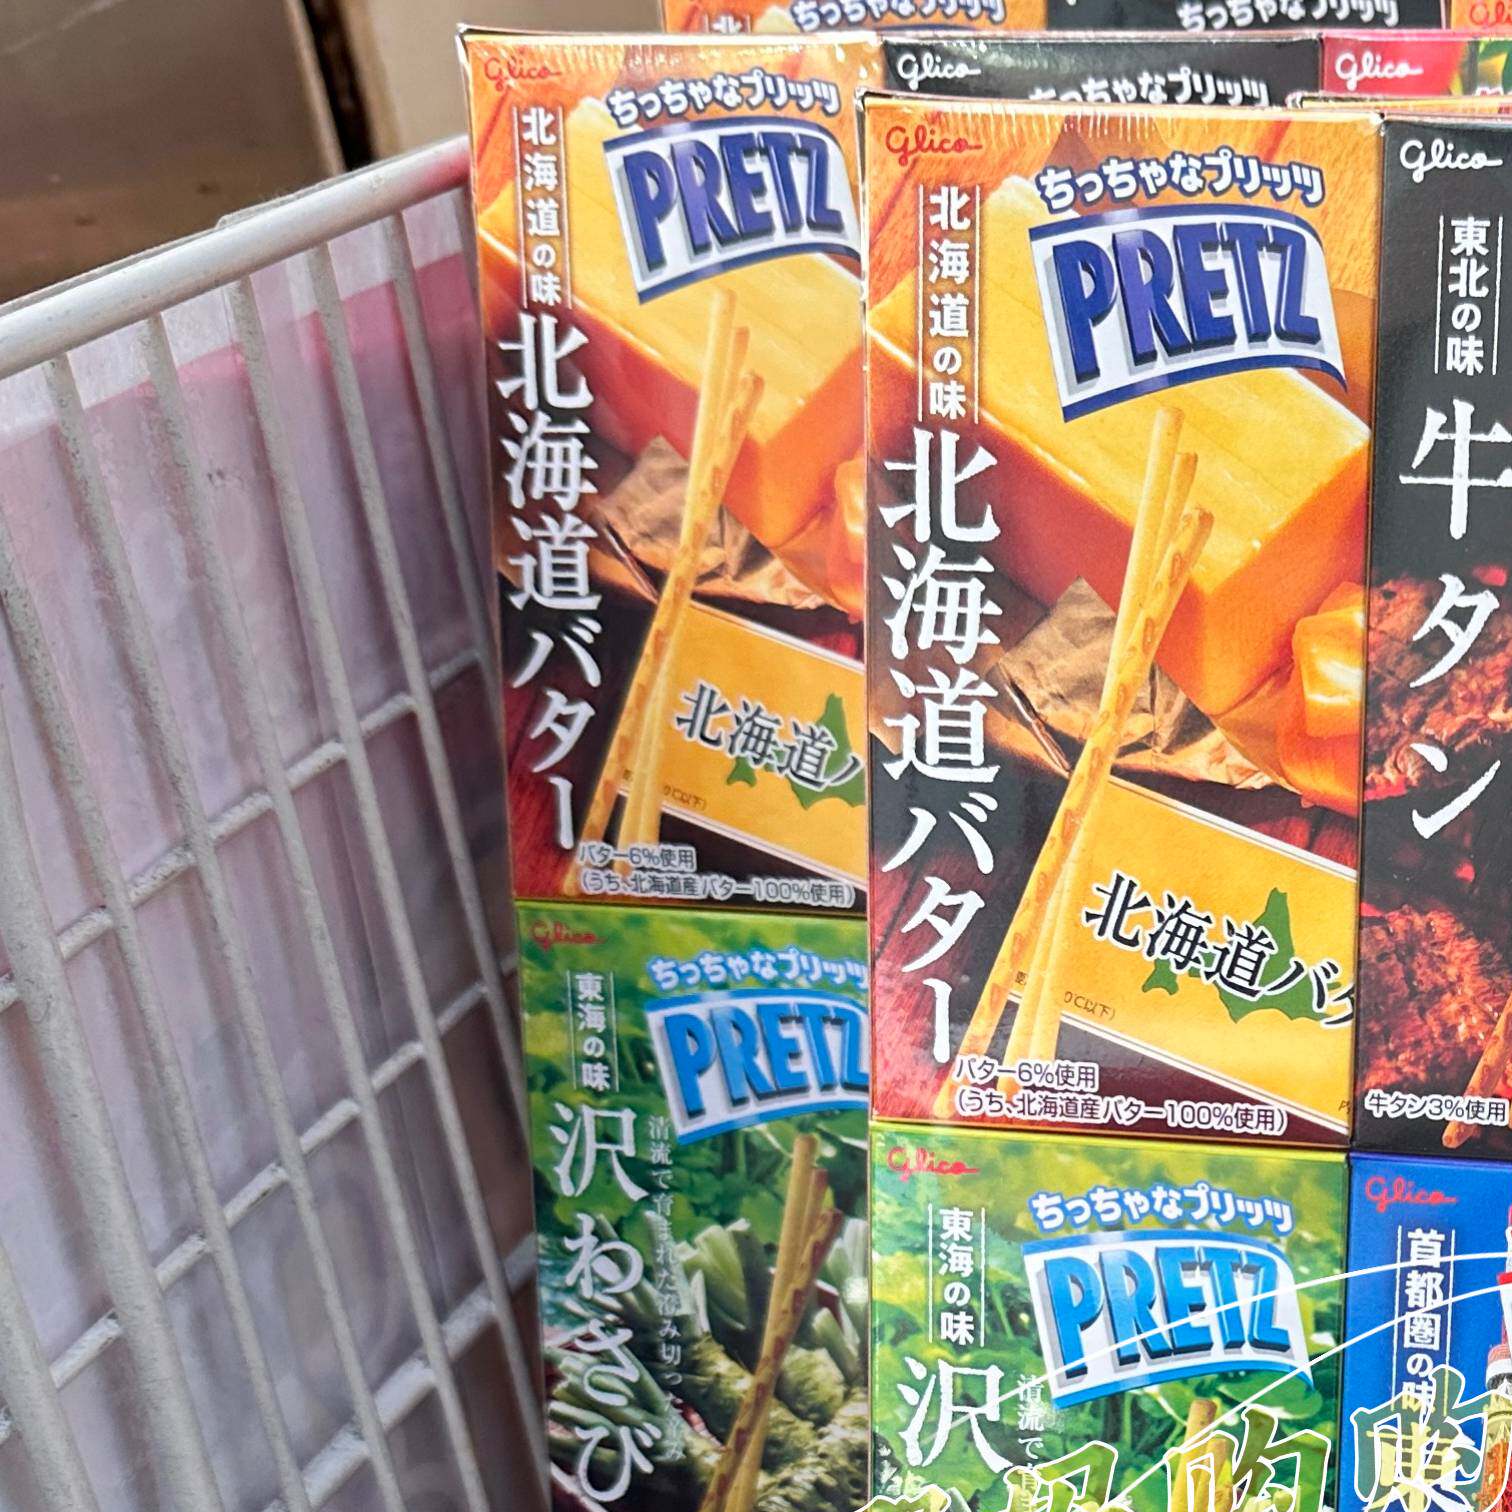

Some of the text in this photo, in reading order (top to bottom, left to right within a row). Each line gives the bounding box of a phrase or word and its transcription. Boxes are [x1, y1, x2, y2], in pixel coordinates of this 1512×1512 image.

[484, 55, 562, 83] Glico
[606, 70, 840, 126] ちっちゃなプリッツ
[898, 54, 981, 90] Glico
[1335, 54, 1423, 94] Glico
[622, 132, 845, 272] PRETZ
[885, 126, 982, 166] Glico
[1040, 148, 1324, 208] ちっちゃなプリッツ
[1400, 139, 1503, 182] Glico
[521, 107, 562, 305] 北海道の味
[927, 186, 971, 421] 北海道の味
[1050, 222, 1322, 386] PRETZ
[1446, 217, 1490, 376] 東北の味
[496, 312, 602, 850] 北海道バター
[878, 427, 1003, 1064] 北海道バター
[575, 973, 611, 1092] 東海の味
[664, 1003, 868, 1120] PRETZ
[955, 1056, 1098, 1092] バター6%使用
[886, 1147, 981, 1182] Glico
[1366, 1092, 1508, 1123] 牛タン3%使用
[1031, 1185, 1294, 1235] ちっちゃなプリッツ
[1366, 1176, 1457, 1212] Glico
[549, 1102, 664, 1502] 沢わさび
[938, 1207, 976, 1346] 東海の味
[1044, 1247, 1292, 1380] PRETZ
[1402, 1229, 1446, 1418] 首都圏の味
